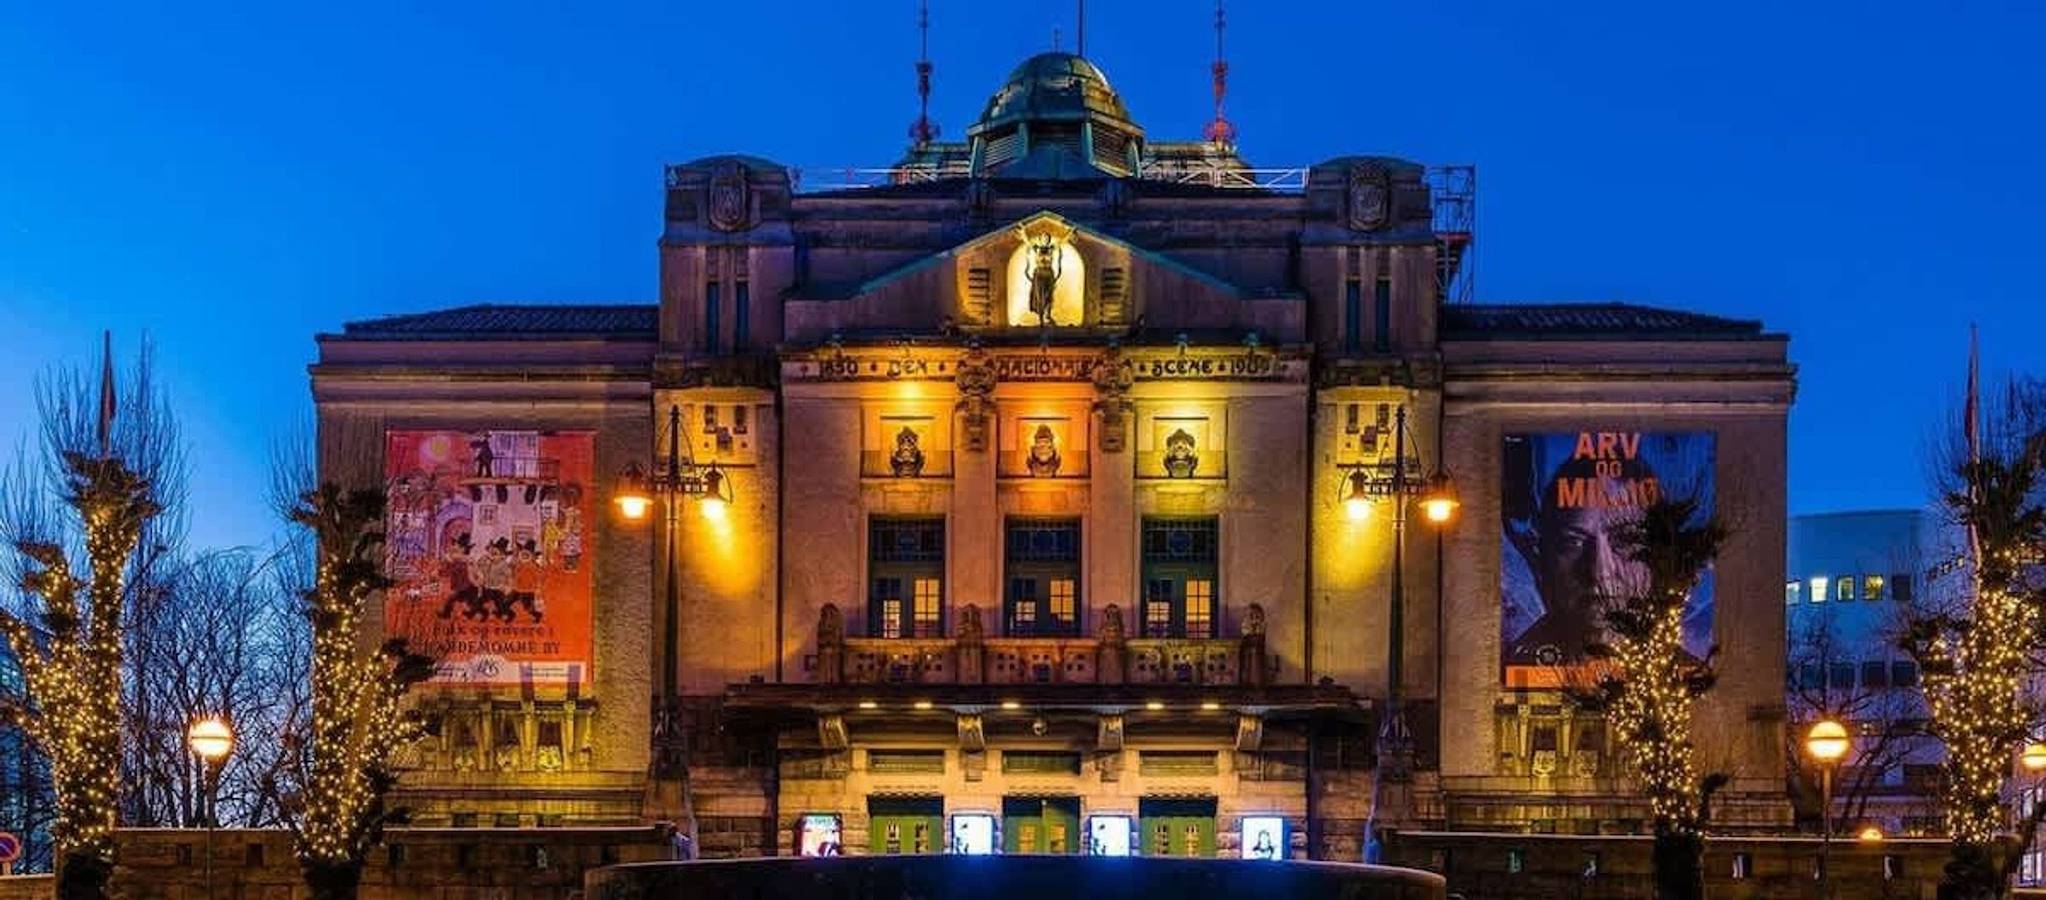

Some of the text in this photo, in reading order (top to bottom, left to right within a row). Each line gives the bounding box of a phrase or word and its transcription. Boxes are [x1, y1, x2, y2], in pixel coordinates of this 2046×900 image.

[1574, 432, 1641, 459] ARV
[1595, 461, 1621, 477] OG
[543, 641, 560, 654] BY
